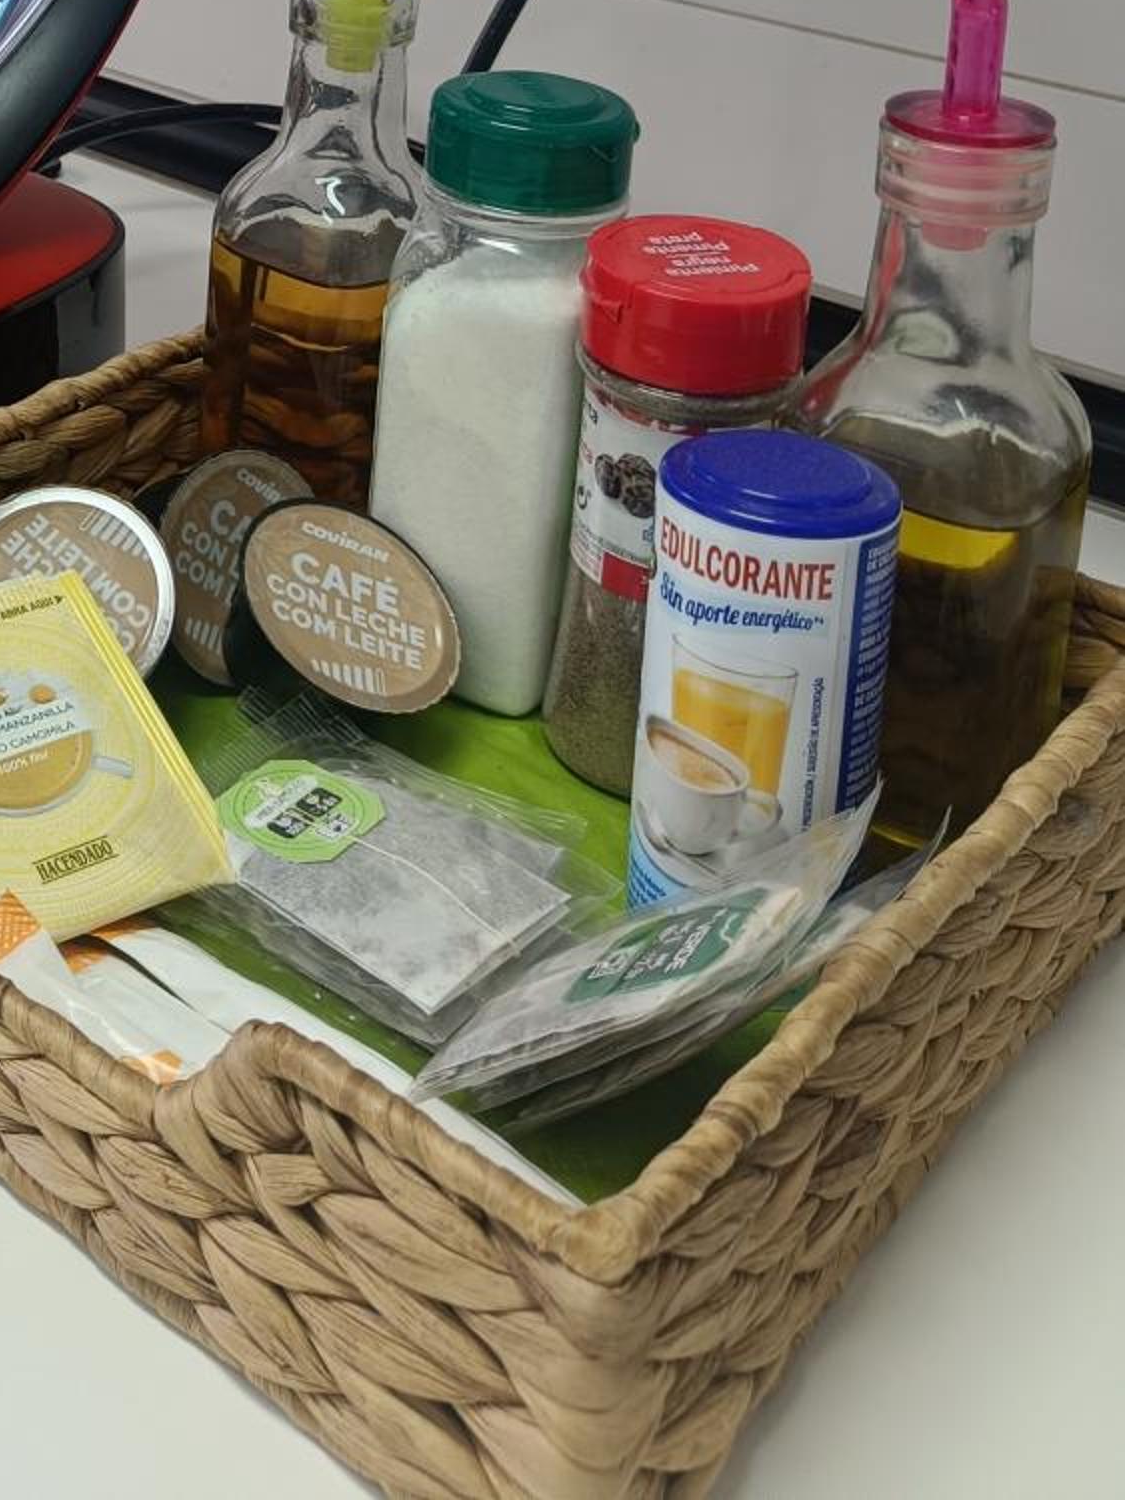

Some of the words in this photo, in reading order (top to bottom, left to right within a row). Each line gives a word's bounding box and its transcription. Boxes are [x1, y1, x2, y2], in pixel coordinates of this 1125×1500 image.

[24, 512, 94, 579] LEITE
[181, 520, 227, 567] CON
[211, 499, 253, 544] CA
[176, 550, 224, 597] COM
[291, 552, 401, 617] CAFÉ
[660, 515, 836, 601] EDULCORANTE
[90, 572, 150, 629] COM
[266, 573, 328, 613] CON
[334, 598, 427, 649] LECHE
[660, 571, 683, 613] Sin
[685, 598, 741, 626] aporte
[271, 599, 337, 641] COM
[343, 625, 423, 671] LEITE
[9, 721, 76, 749] CAMOMILA
[35, 838, 114, 882] HACENDADO
